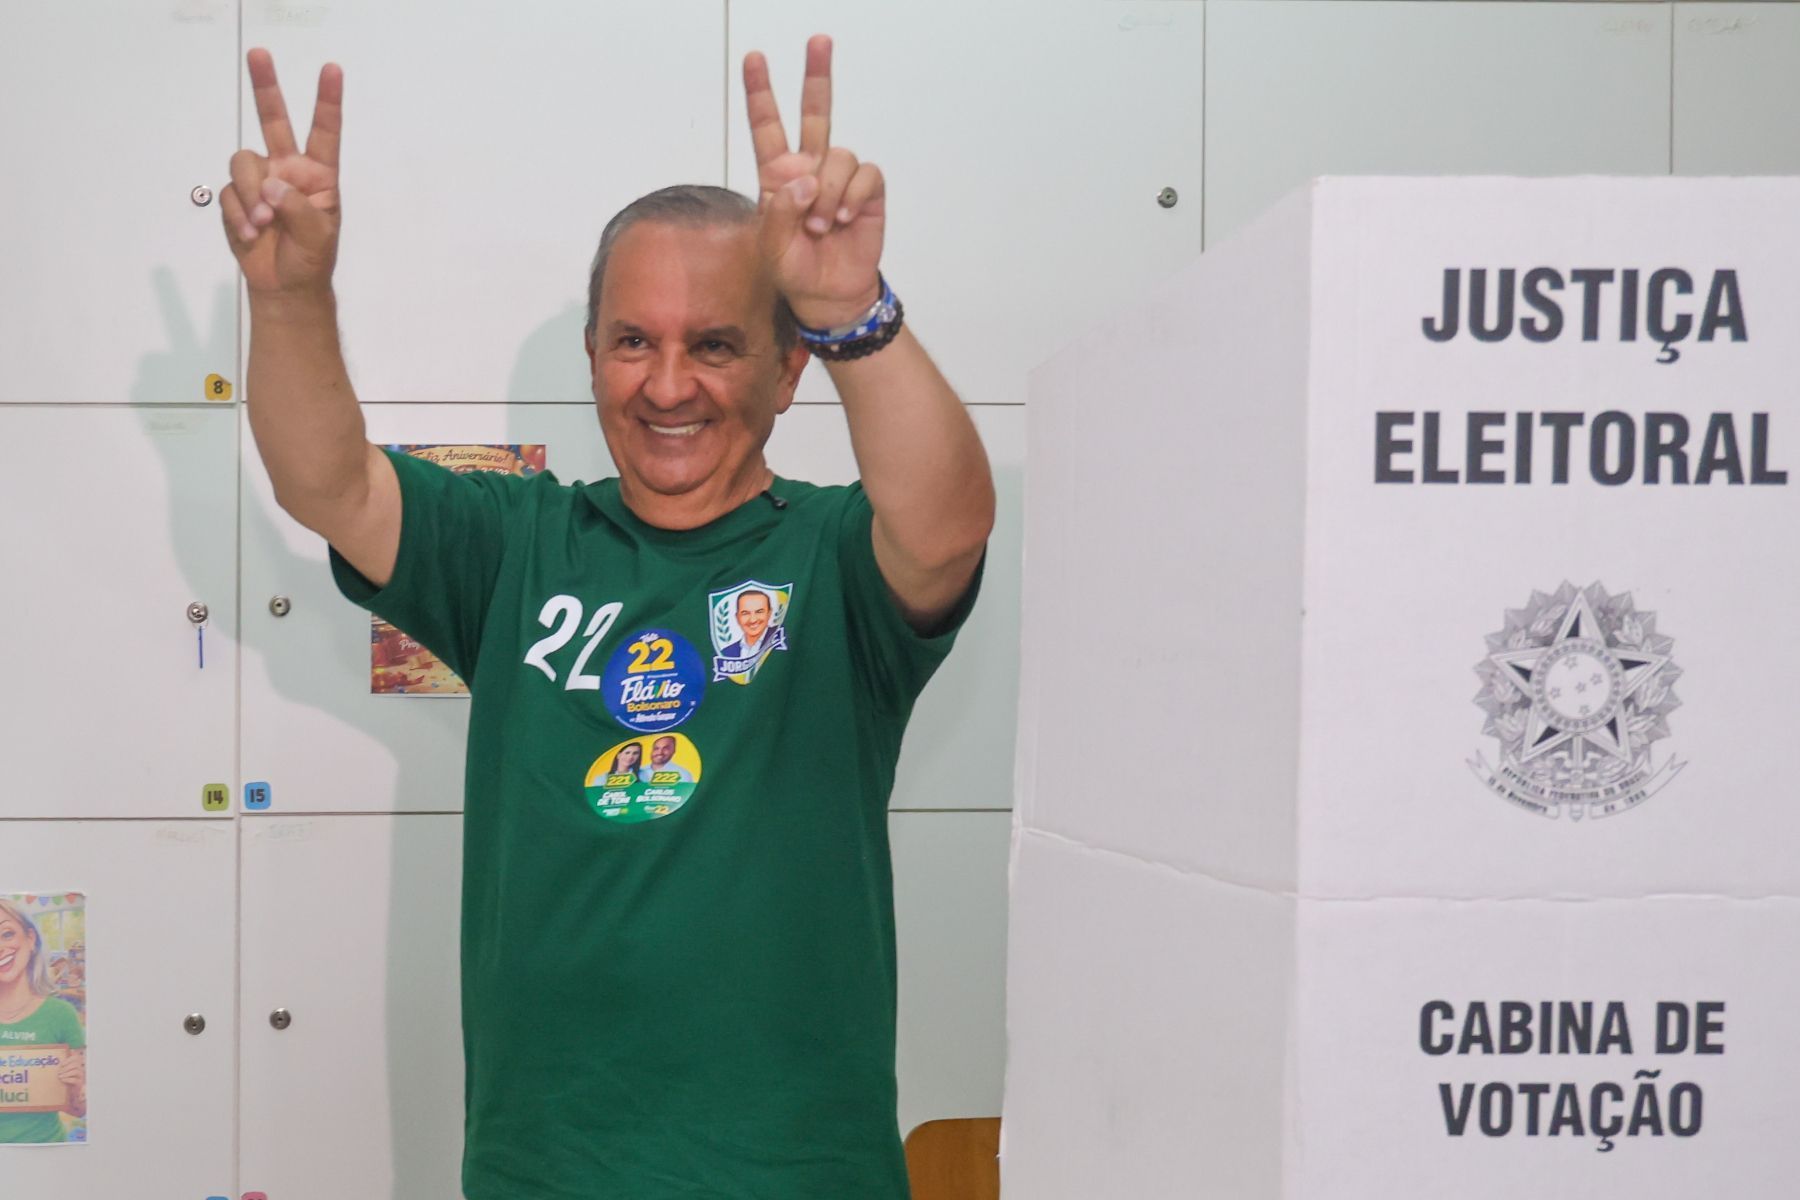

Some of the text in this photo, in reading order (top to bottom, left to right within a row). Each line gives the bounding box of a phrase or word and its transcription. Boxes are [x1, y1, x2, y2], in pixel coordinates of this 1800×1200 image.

[1421, 267, 1749, 364] JUSTIÇA
[213, 380, 224, 394] 8
[1374, 410, 1789, 486] ELEITORAL
[523, 594, 623, 691] 22
[627, 638, 675, 674] 22
[627, 700, 681, 712] Bolsonaro
[207, 790, 224, 804] 14
[250, 789, 265, 803] 15
[1419, 1000, 1725, 1056] CABINA DE
[8, 1055, 59, 1068] Educação
[1438, 1069, 1703, 1152] VOTAÇÃO
